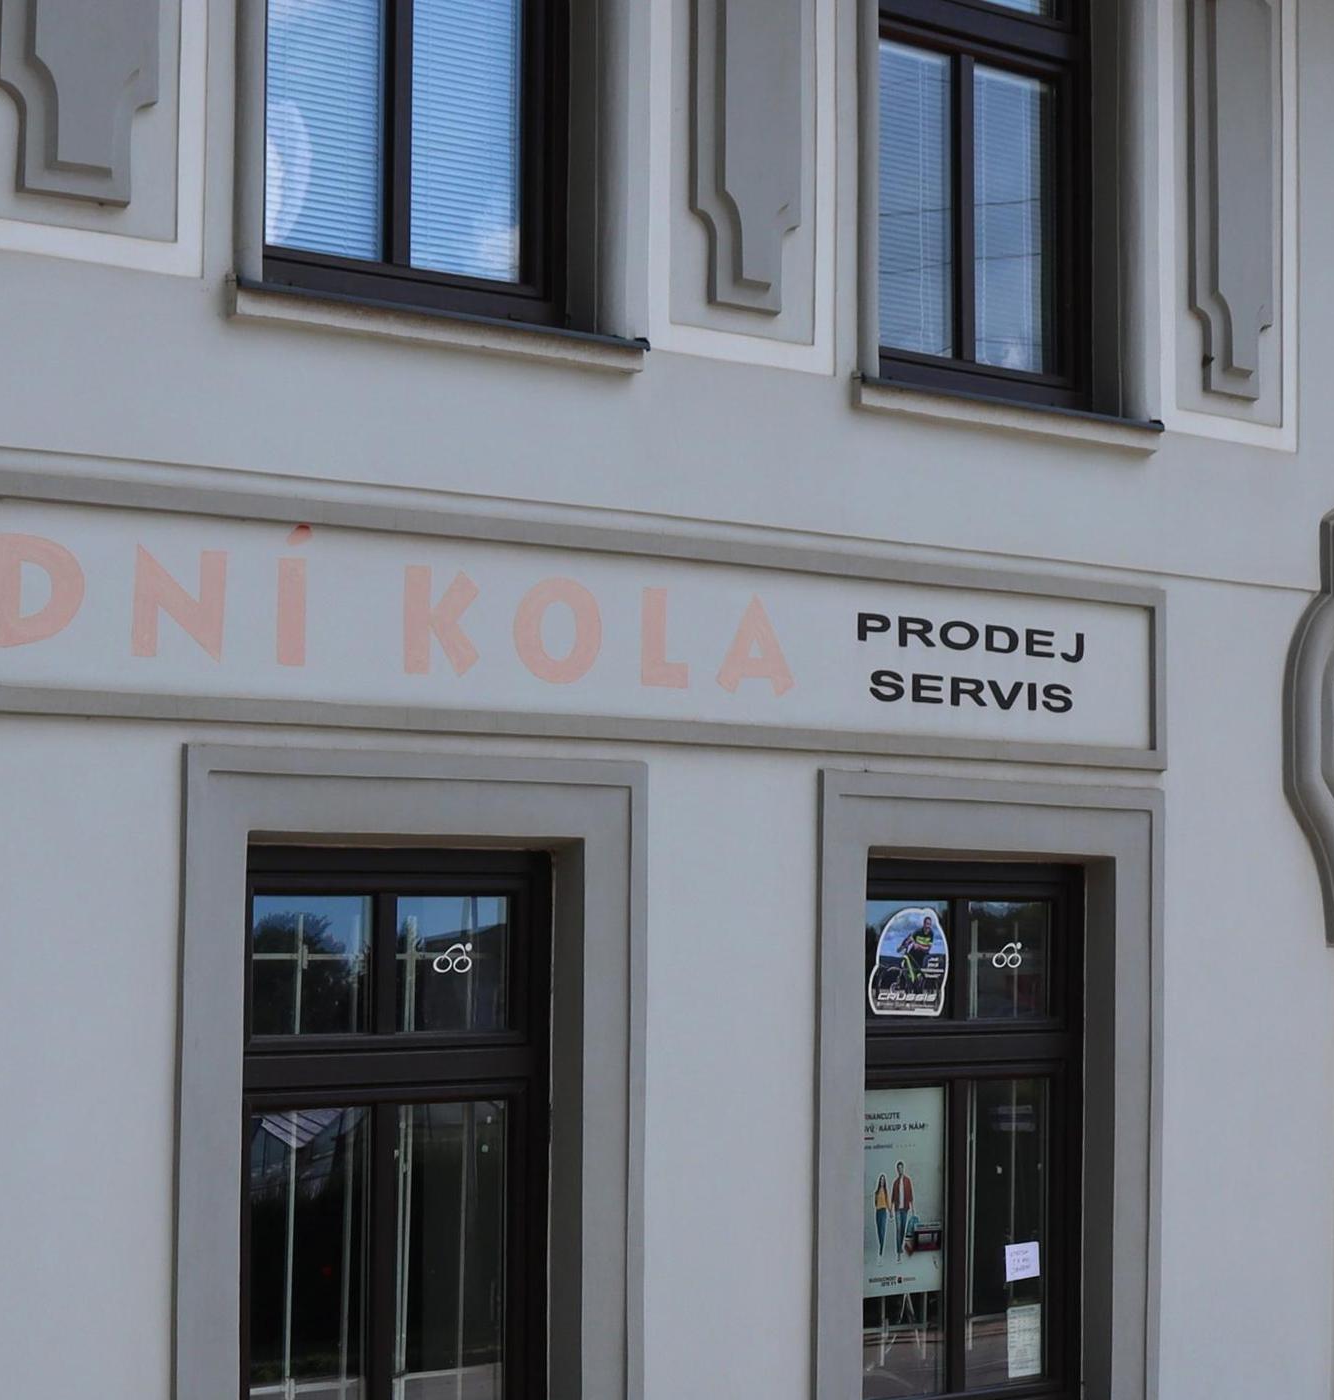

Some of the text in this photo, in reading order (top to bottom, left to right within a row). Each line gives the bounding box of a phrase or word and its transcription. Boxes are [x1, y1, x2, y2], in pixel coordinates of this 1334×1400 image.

[402, 563, 795, 698] KOLA
[856, 612, 1087, 664] PRODEJ
[869, 669, 1074, 714] SERVIS
